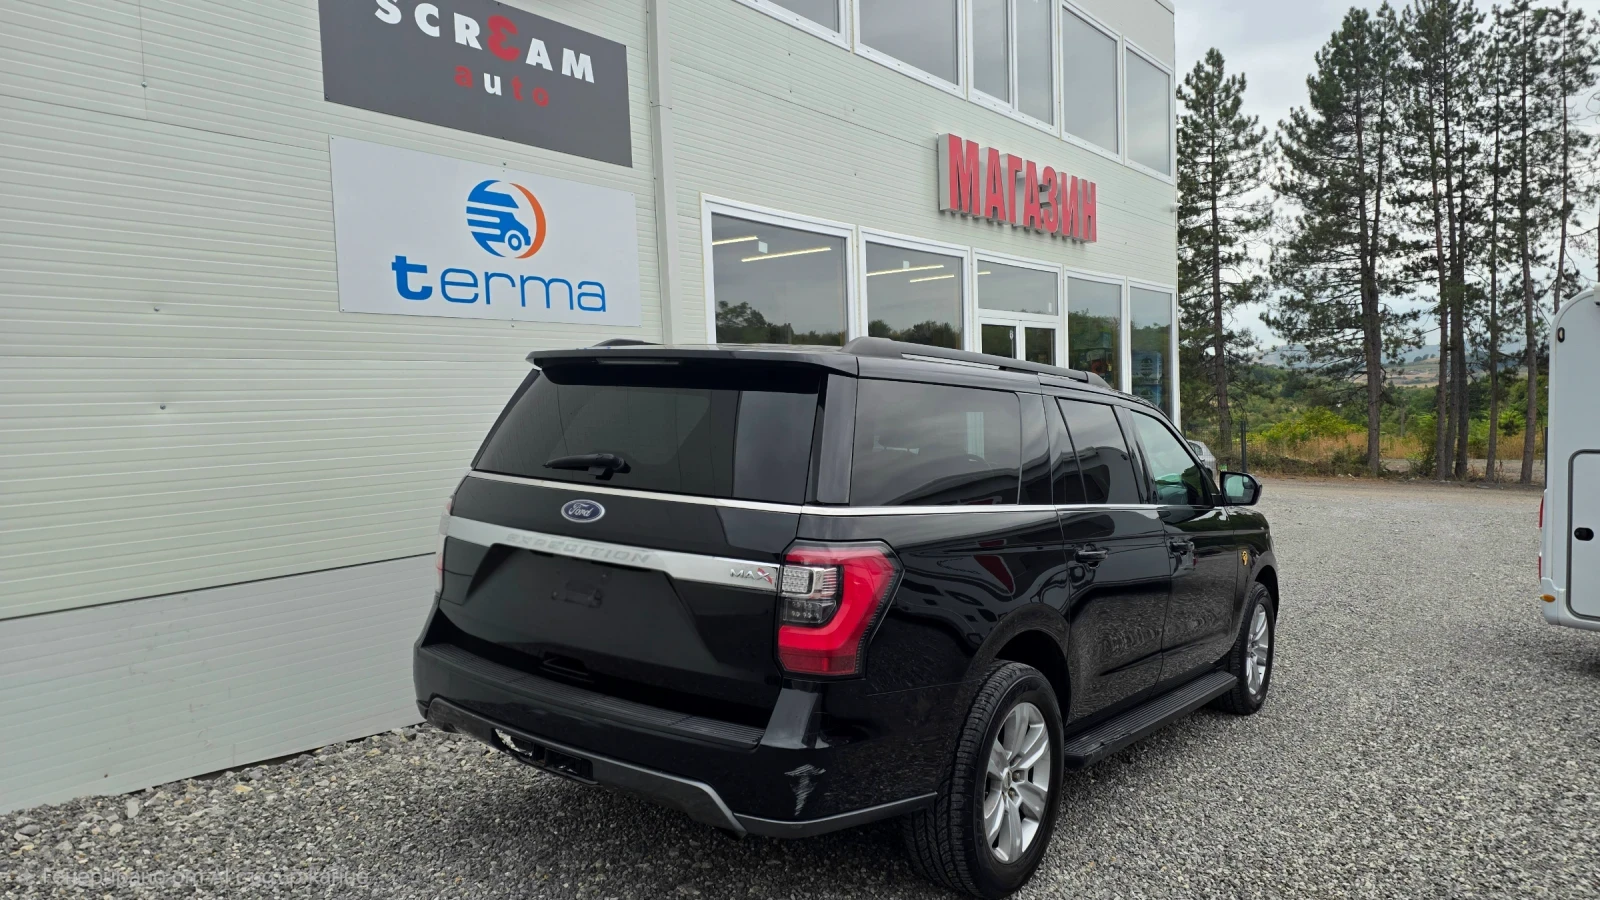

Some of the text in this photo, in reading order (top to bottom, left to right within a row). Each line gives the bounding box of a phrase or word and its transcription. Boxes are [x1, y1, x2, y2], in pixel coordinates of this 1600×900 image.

[454, 65, 549, 107] auto
[947, 133, 1097, 243] МАГАЗИН
[391, 255, 607, 312] terma
[506, 533, 649, 563] EXPEDITION
[730, 567, 773, 585] MAX
